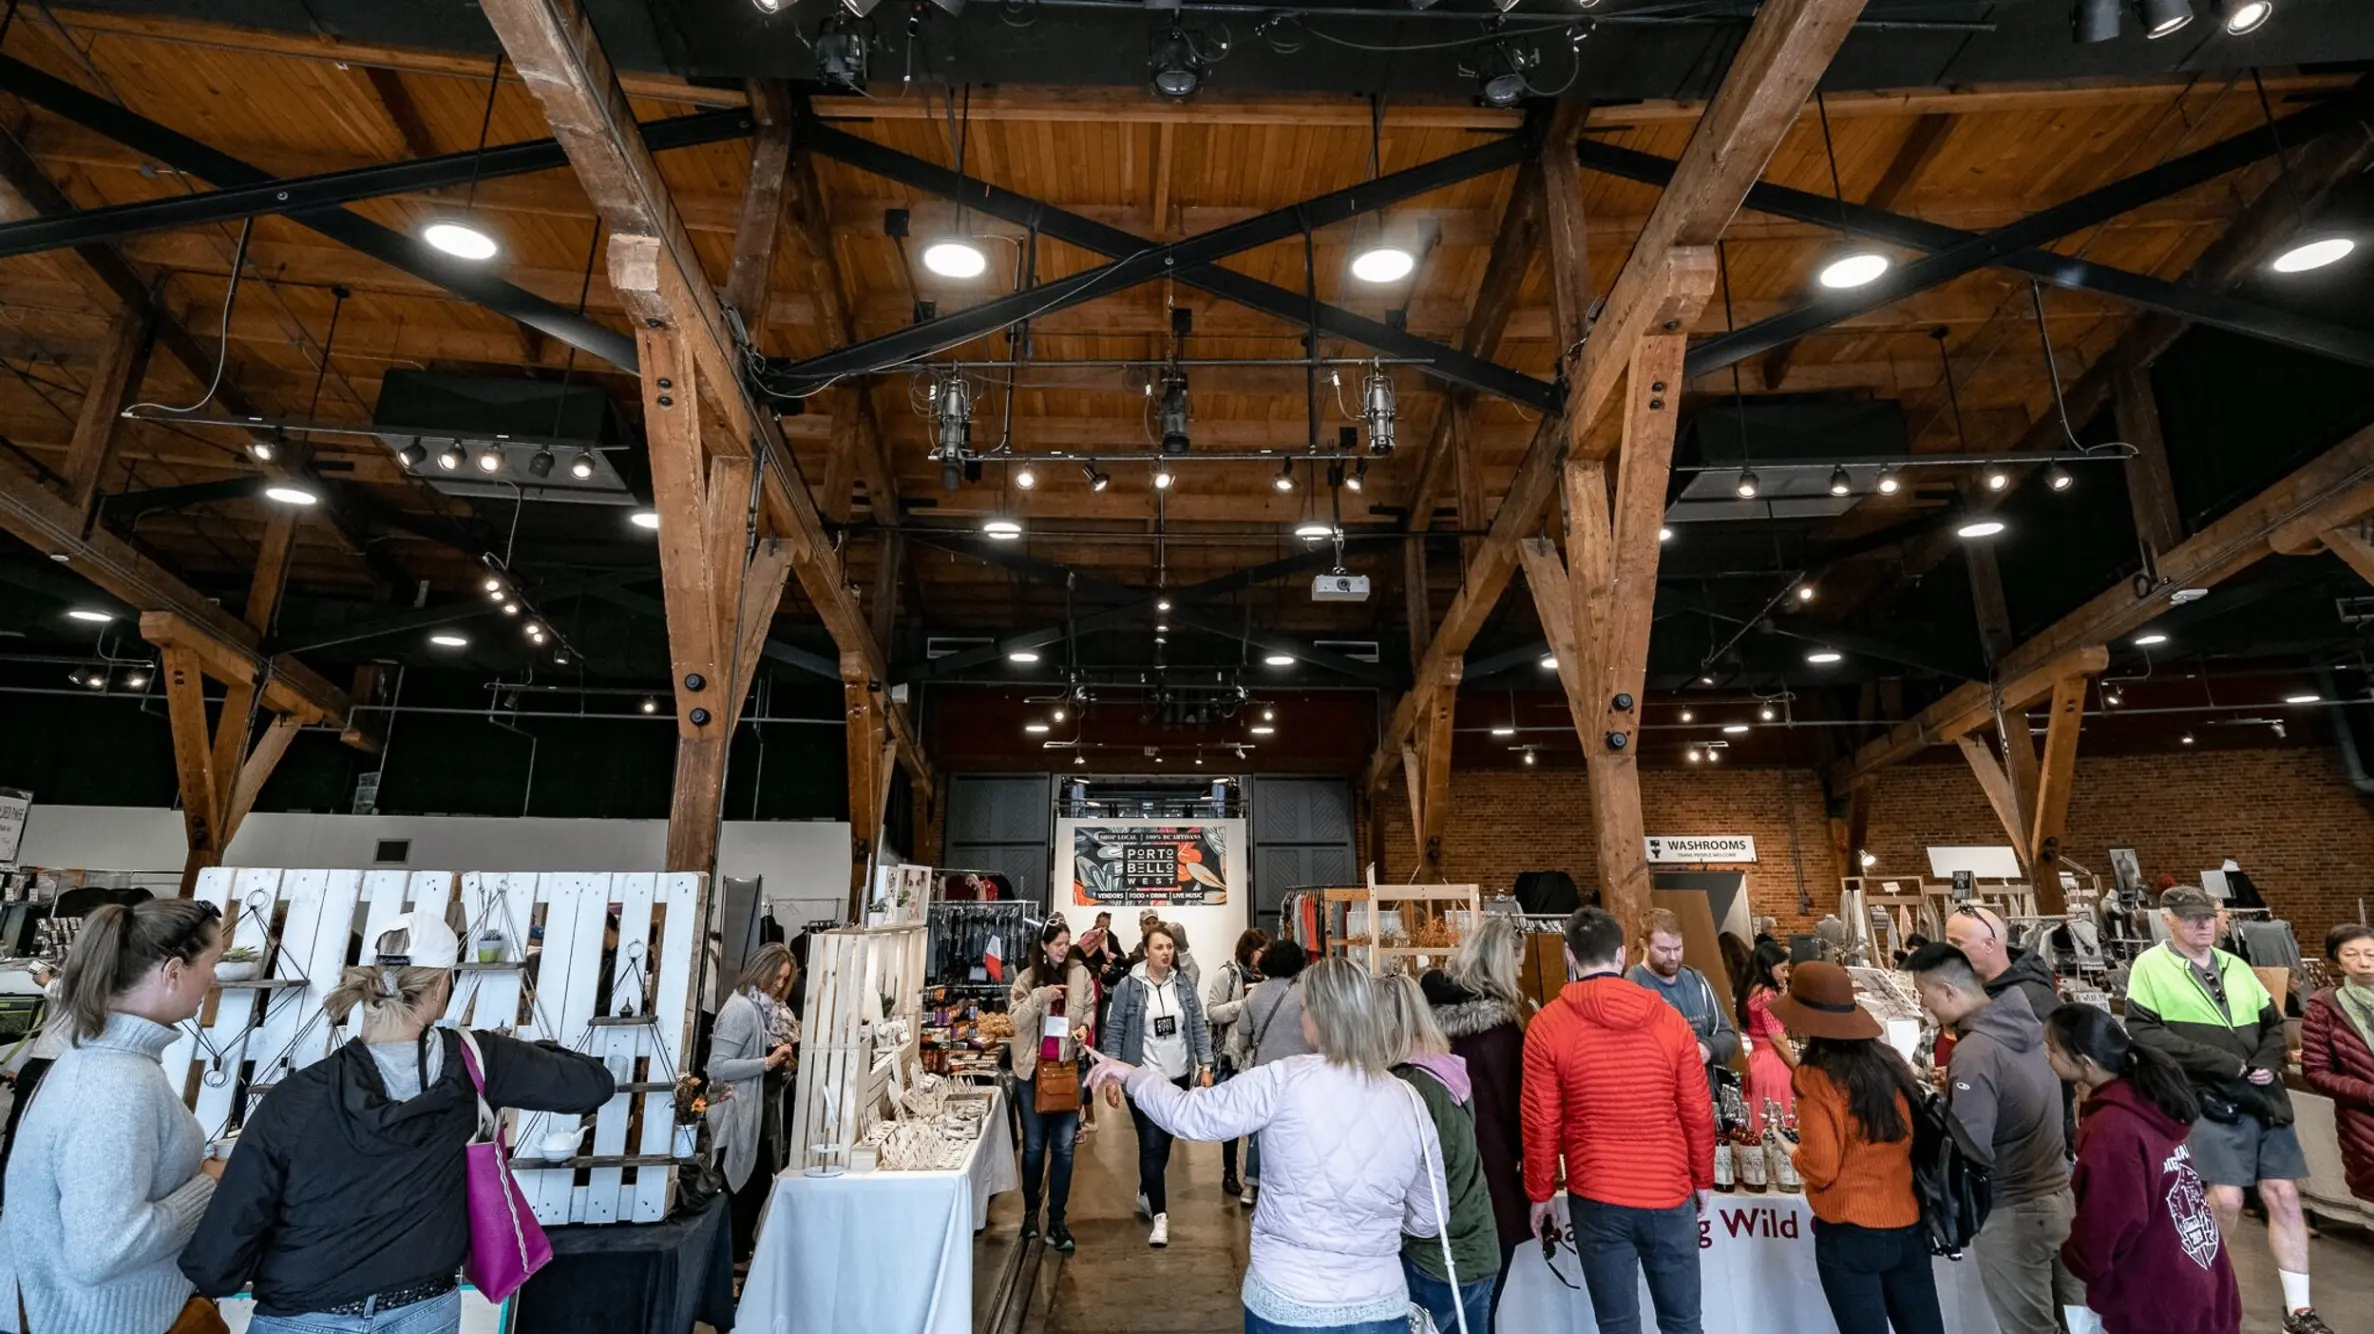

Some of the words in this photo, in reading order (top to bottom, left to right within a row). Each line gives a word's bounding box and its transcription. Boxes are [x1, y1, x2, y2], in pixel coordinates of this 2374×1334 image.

[1668, 840, 1746, 850] WASHROOMS
[1127, 848, 1174, 860] PORTO
[1127, 862, 1174, 874] BELLO
[1127, 877, 1174, 885] WEST
[1718, 1207, 1799, 1239] Wild
